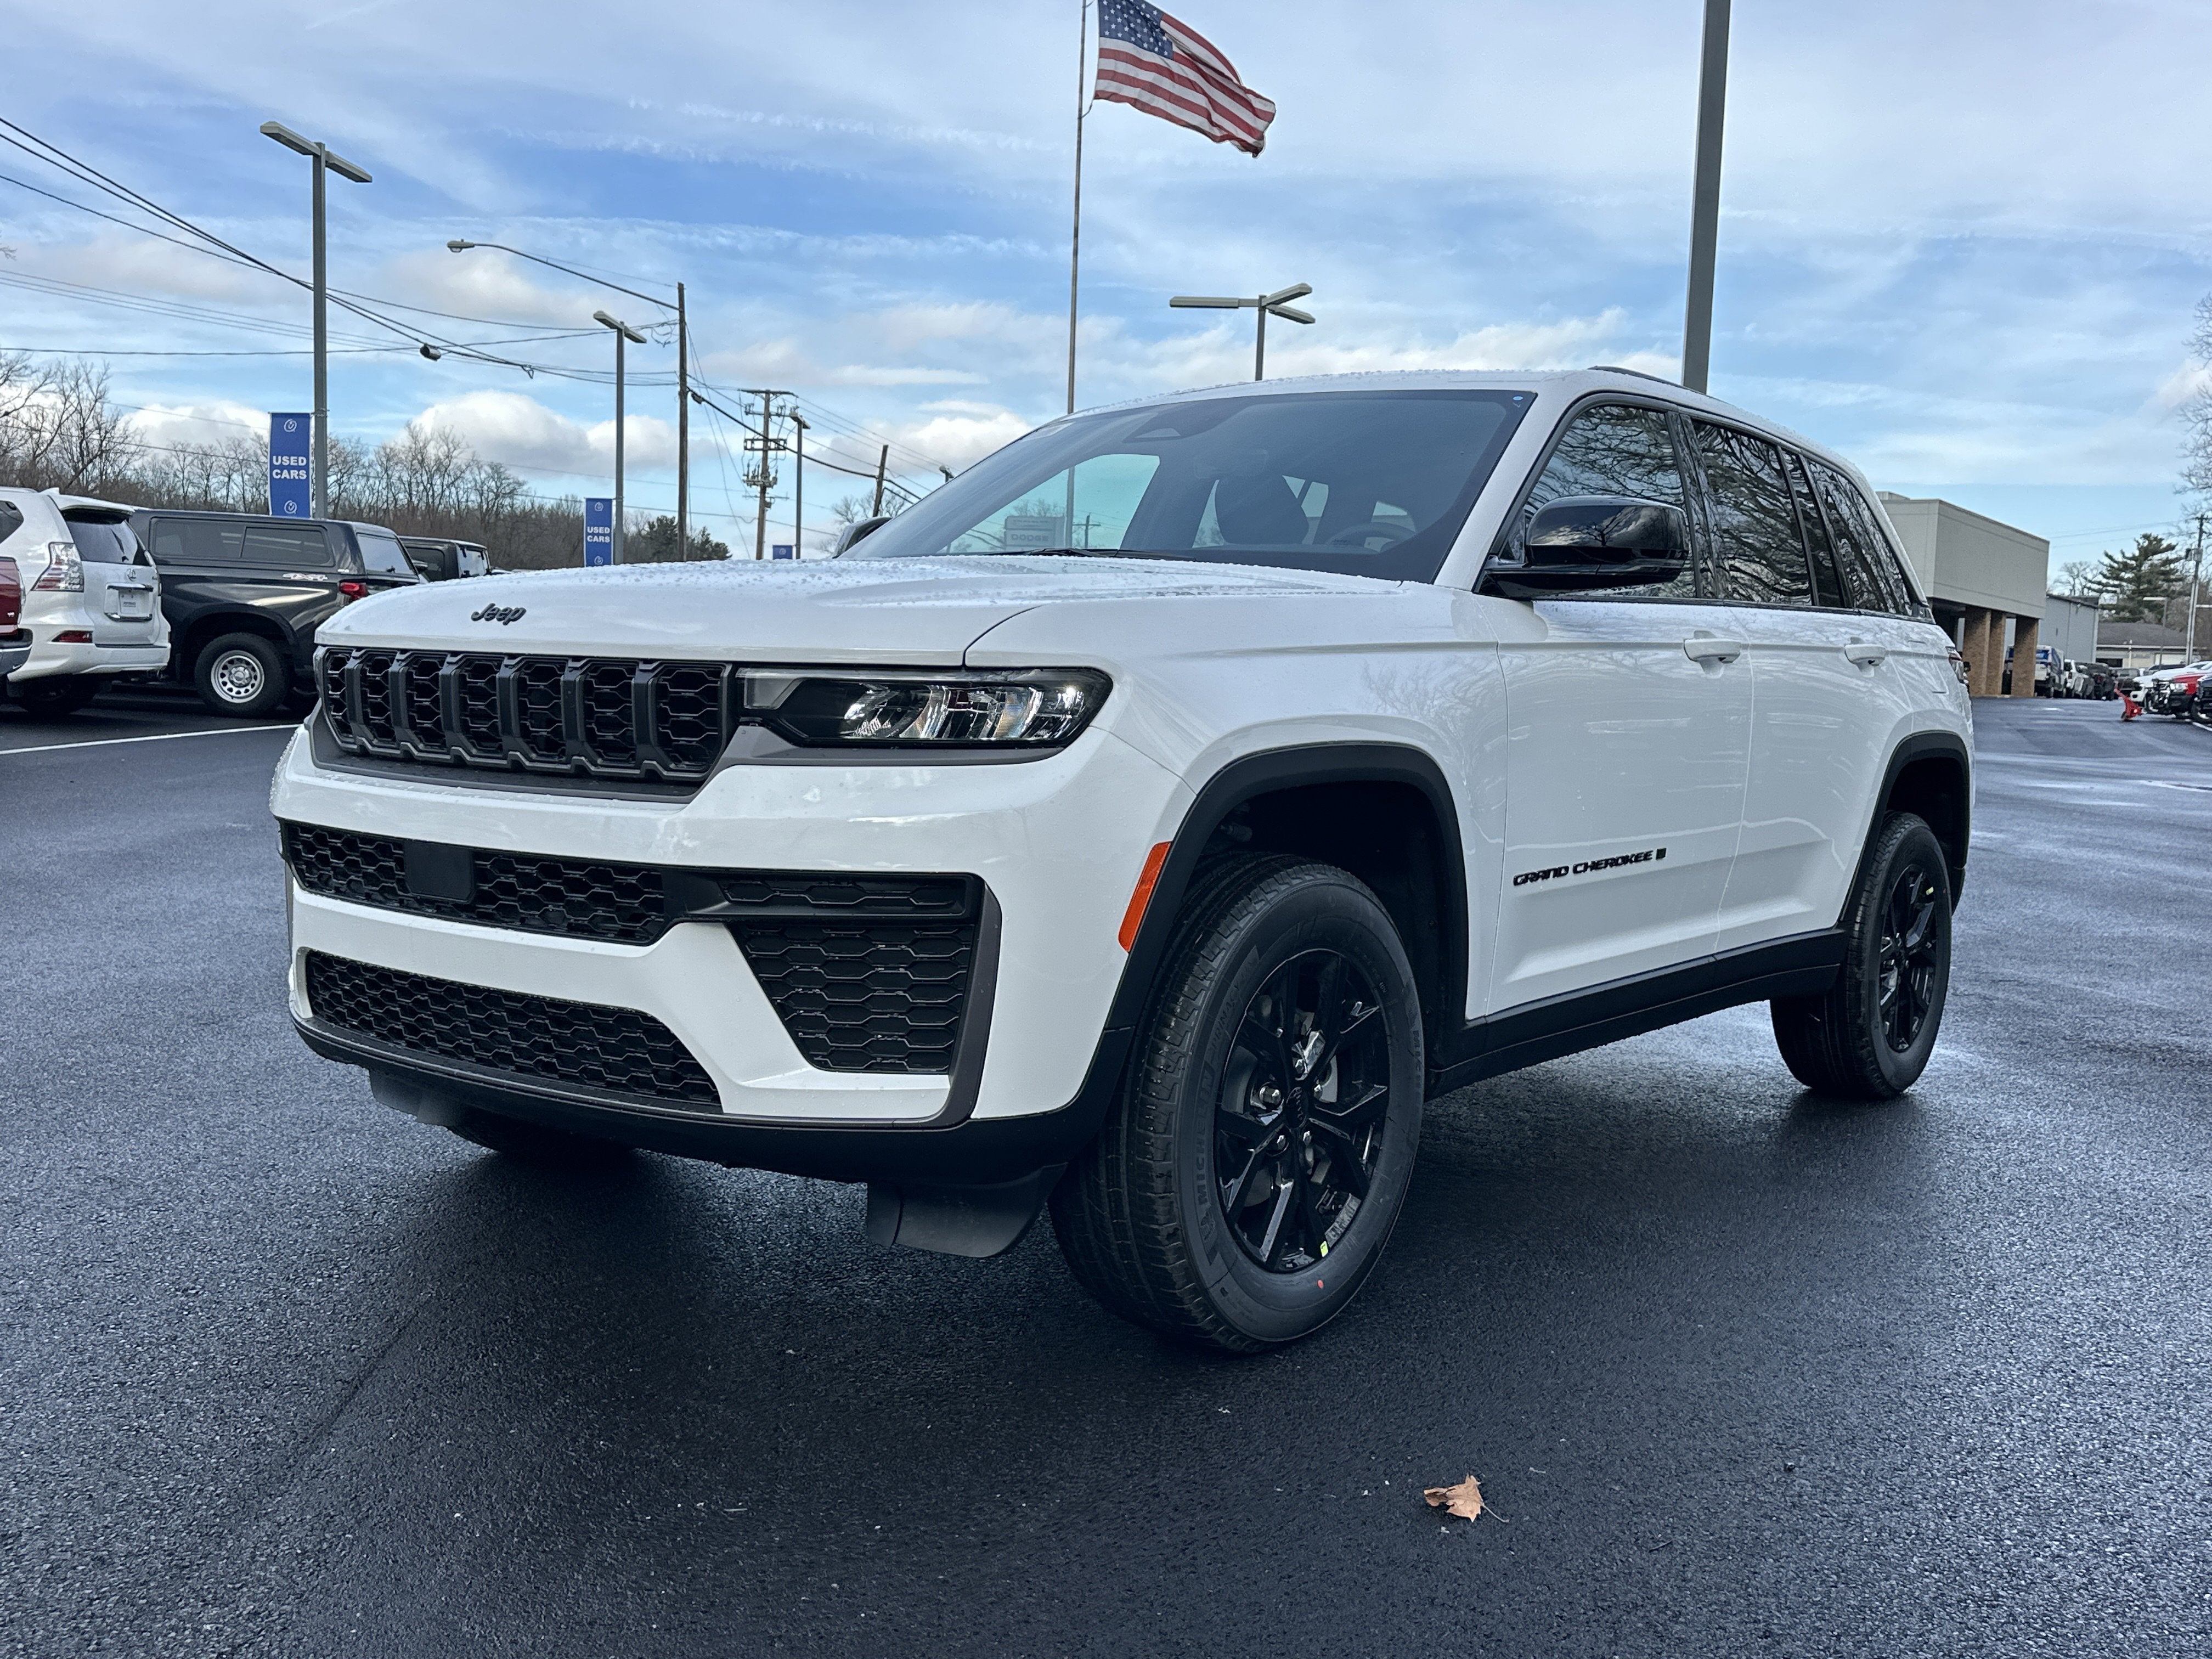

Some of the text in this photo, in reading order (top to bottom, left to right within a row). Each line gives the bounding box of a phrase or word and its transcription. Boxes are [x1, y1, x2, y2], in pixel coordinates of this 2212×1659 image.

[273, 456, 307, 466] USED
[272, 469, 307, 480] CARS
[471, 603, 527, 625] Jeep
[1513, 850, 1654, 886] GRAND CHEROKEE
